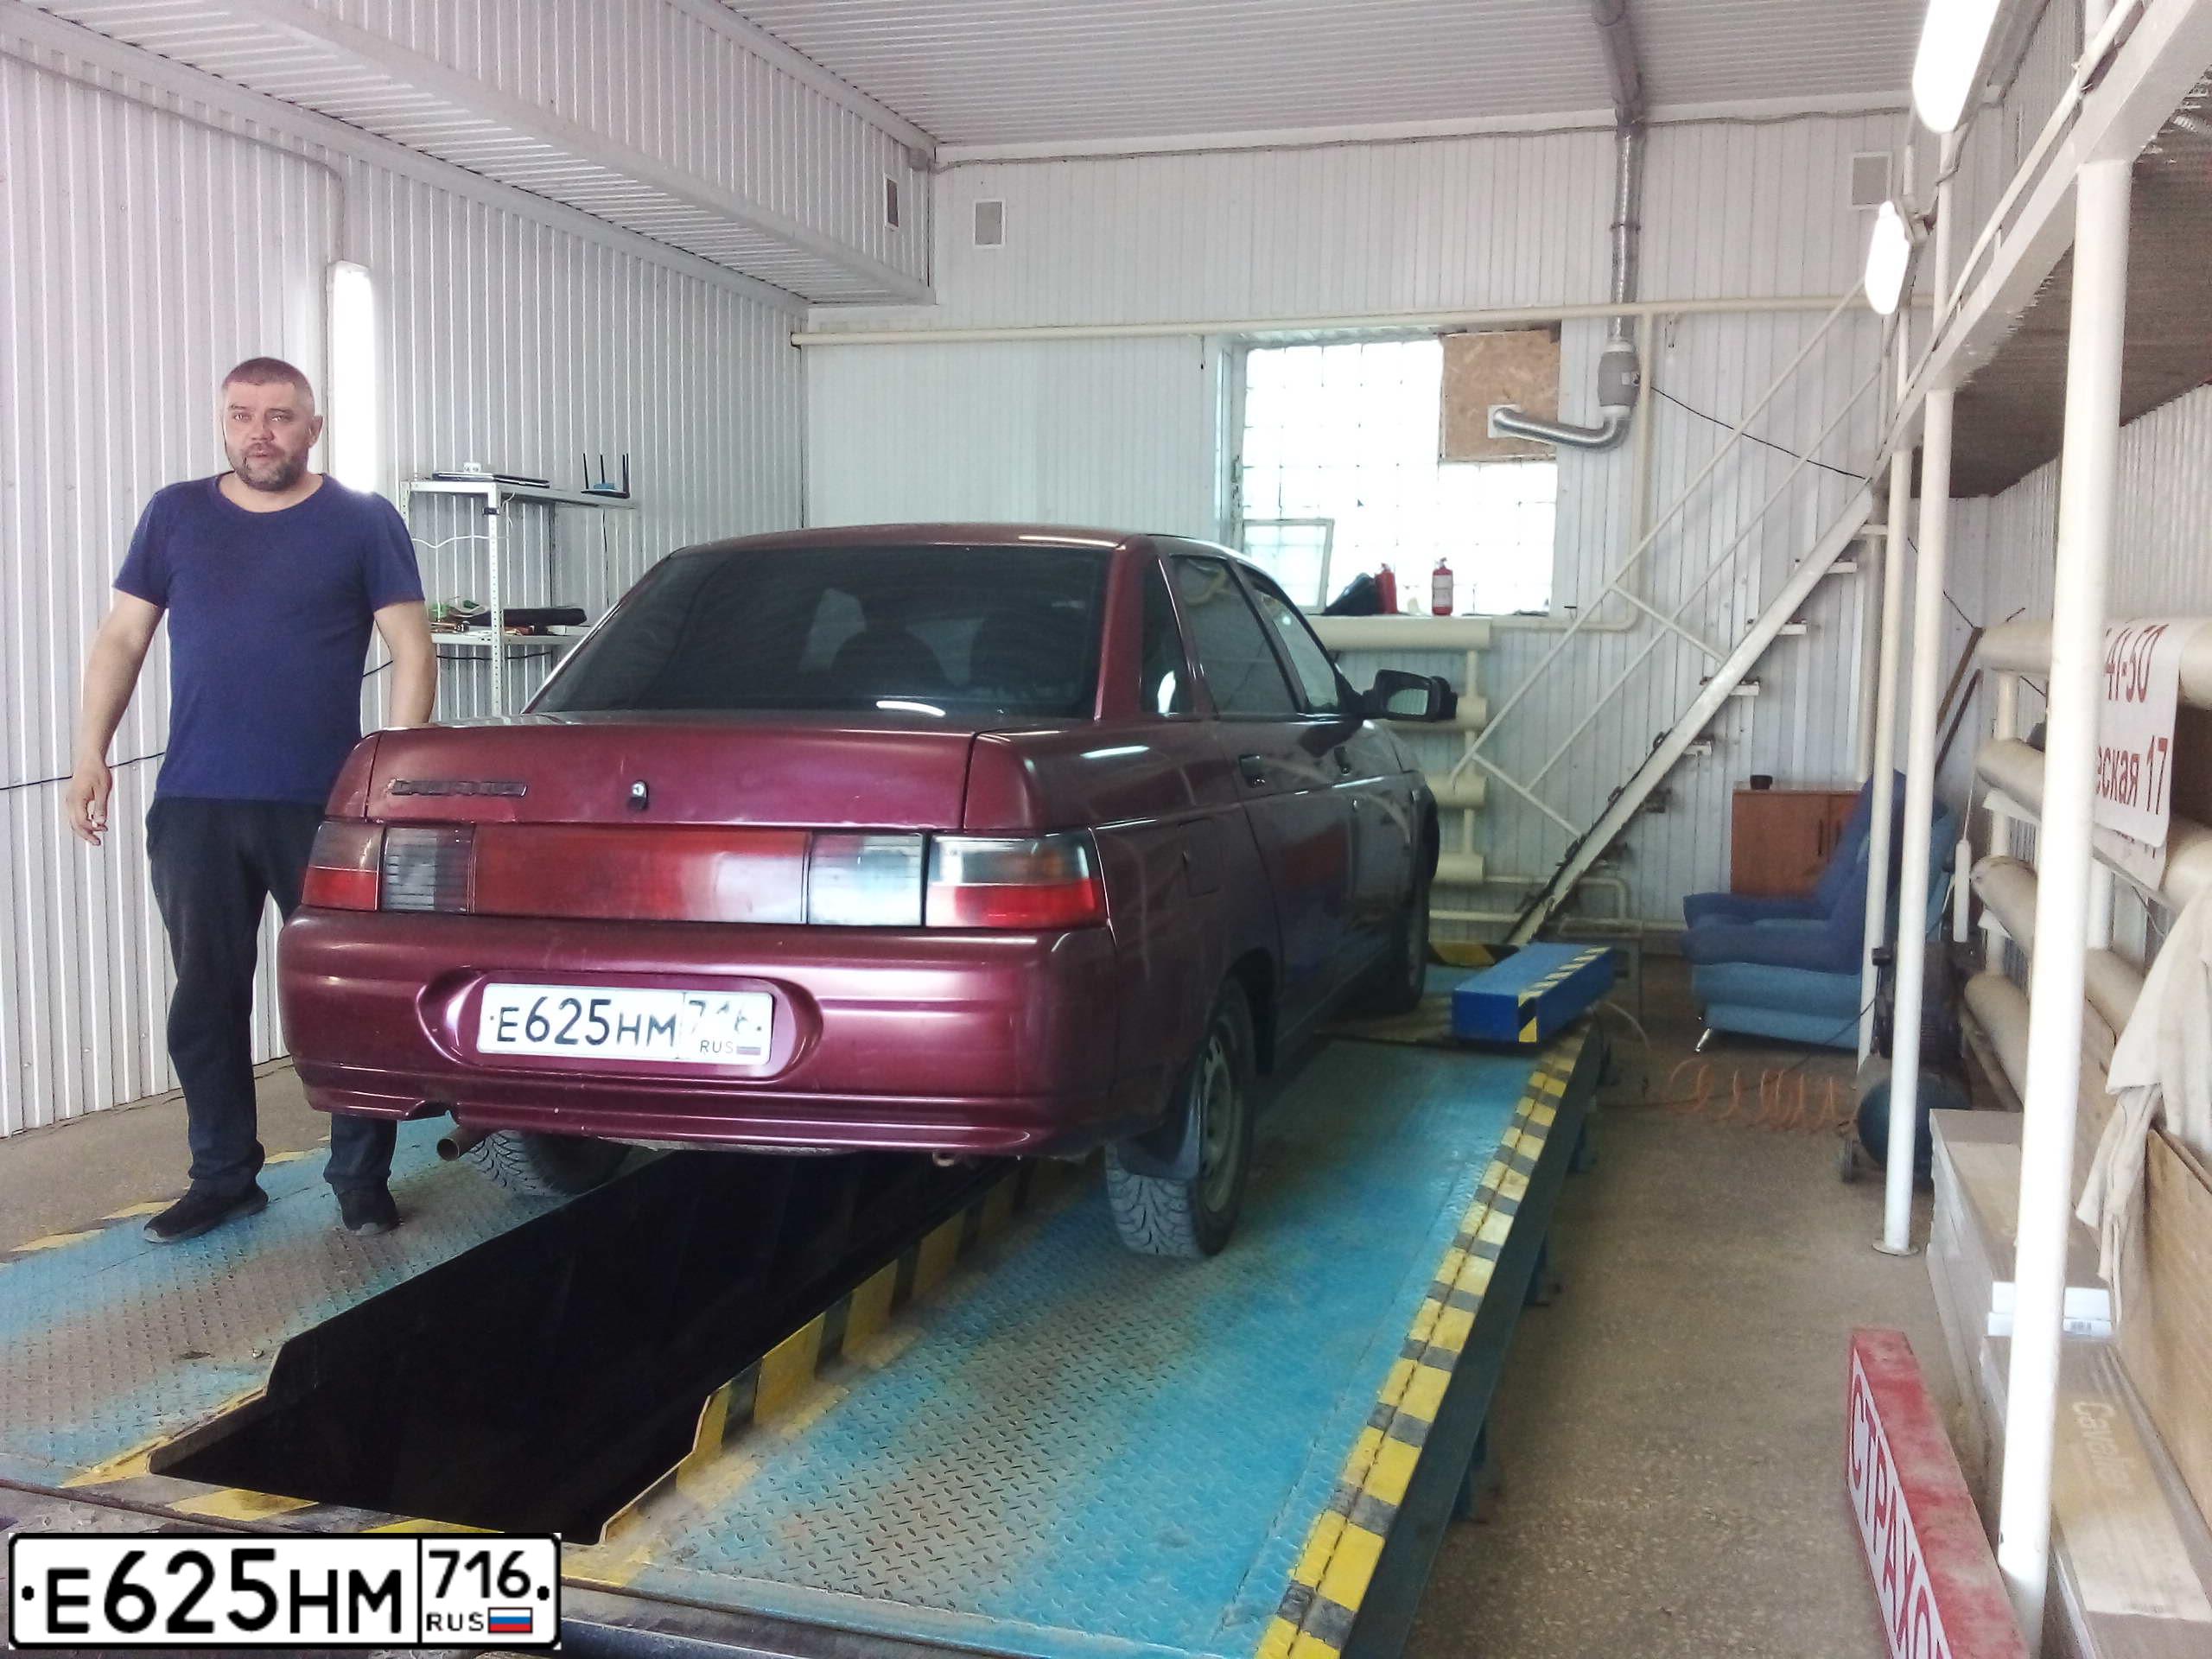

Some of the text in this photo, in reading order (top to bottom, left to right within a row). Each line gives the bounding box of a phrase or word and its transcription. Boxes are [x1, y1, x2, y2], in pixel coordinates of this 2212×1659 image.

[2146, 734, 2168, 815] 17
[496, 995, 677, 1048] Е625НМ
[699, 1039, 734, 1055] RUS
[1852, 1373, 1944, 1659] СТРАХО
